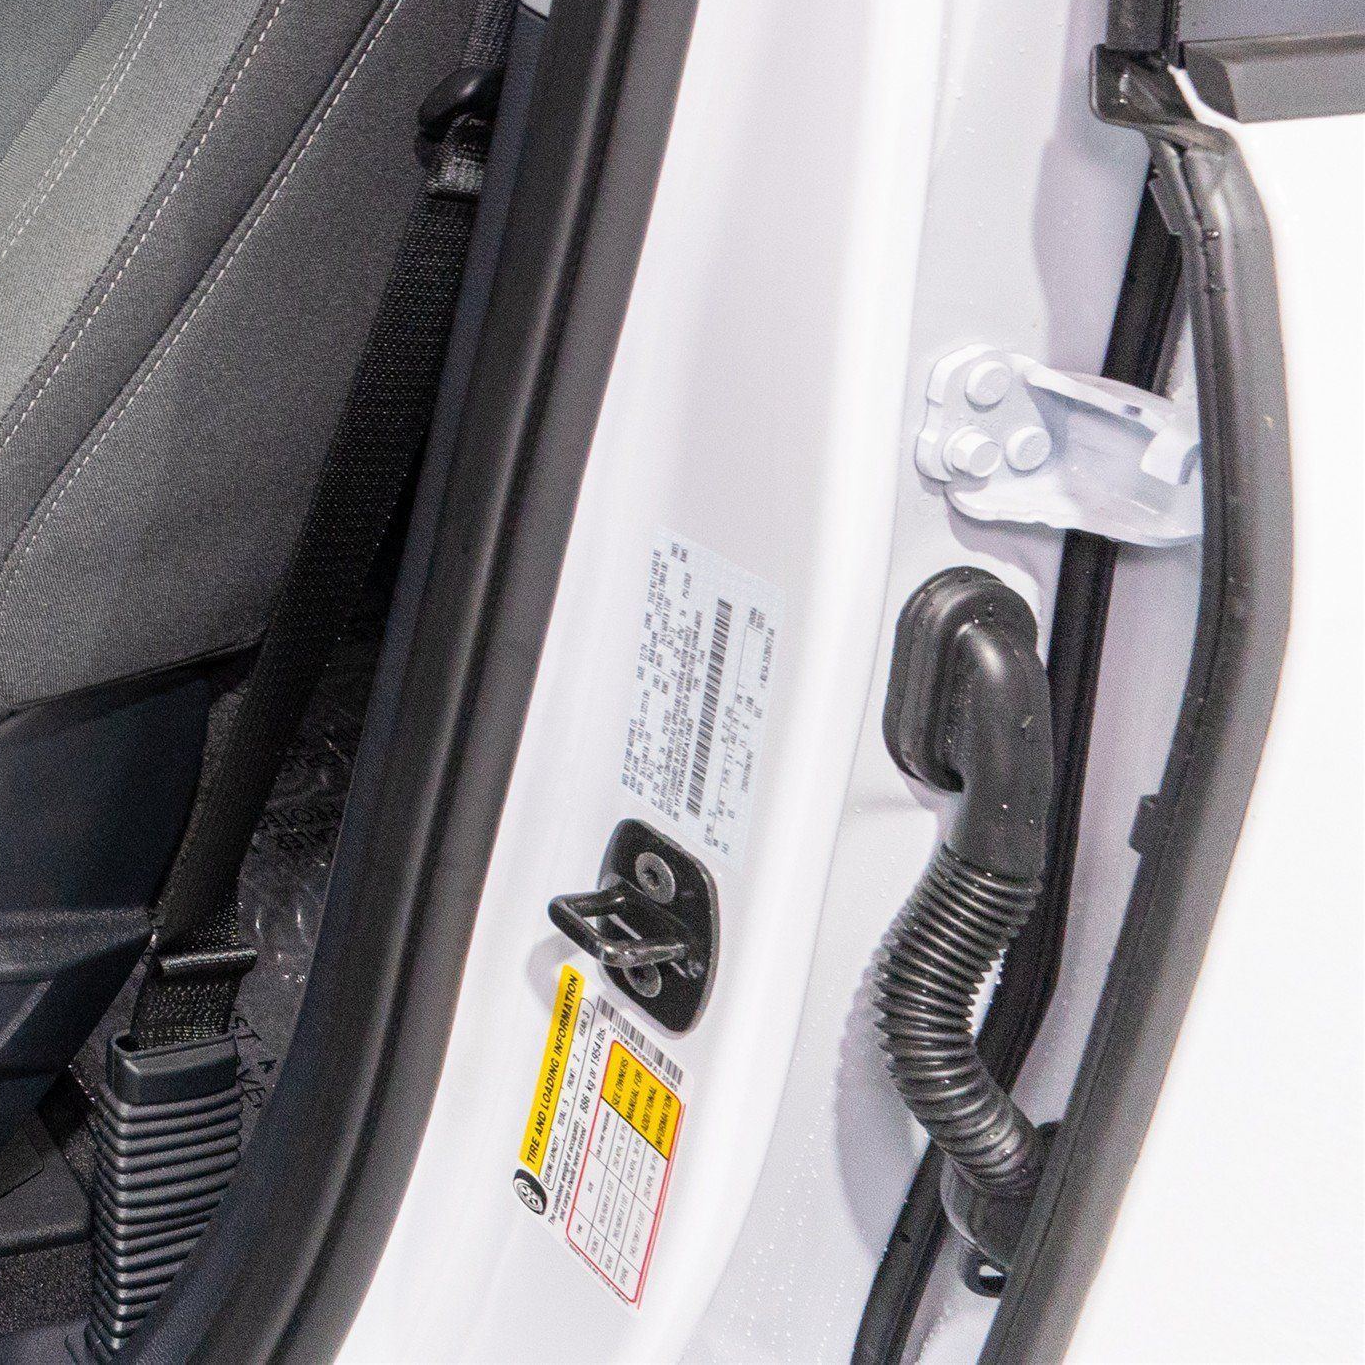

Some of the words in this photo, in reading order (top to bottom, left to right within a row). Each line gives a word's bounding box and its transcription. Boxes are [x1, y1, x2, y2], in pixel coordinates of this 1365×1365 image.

[526, 1136, 540, 1164] TIRE
[534, 1110, 546, 1137] AND
[541, 1058, 559, 1110] LOADING
[554, 975, 577, 1055] INFORMATION
[590, 1041, 602, 1065] 1954
[585, 1079, 596, 1092] kg
[589, 1067, 596, 1080] or
[615, 1059, 628, 1091] OWNERS
[579, 1093, 590, 1114] 886
[611, 1091, 621, 1108] SEE
[626, 1090, 639, 1121] MANUAL
[633, 1069, 642, 1087] FOR
[641, 1087, 657, 1132] ADDITIONAL
[655, 1094, 672, 1148] INFORMATION
[547, 1212, 556, 1225] The
[553, 1182, 564, 1213] combined
[561, 1160, 570, 1182] weight
[562, 1189, 571, 1209] cargo
[567, 1167, 576, 1189] should
[572, 1150, 580, 1167] never
